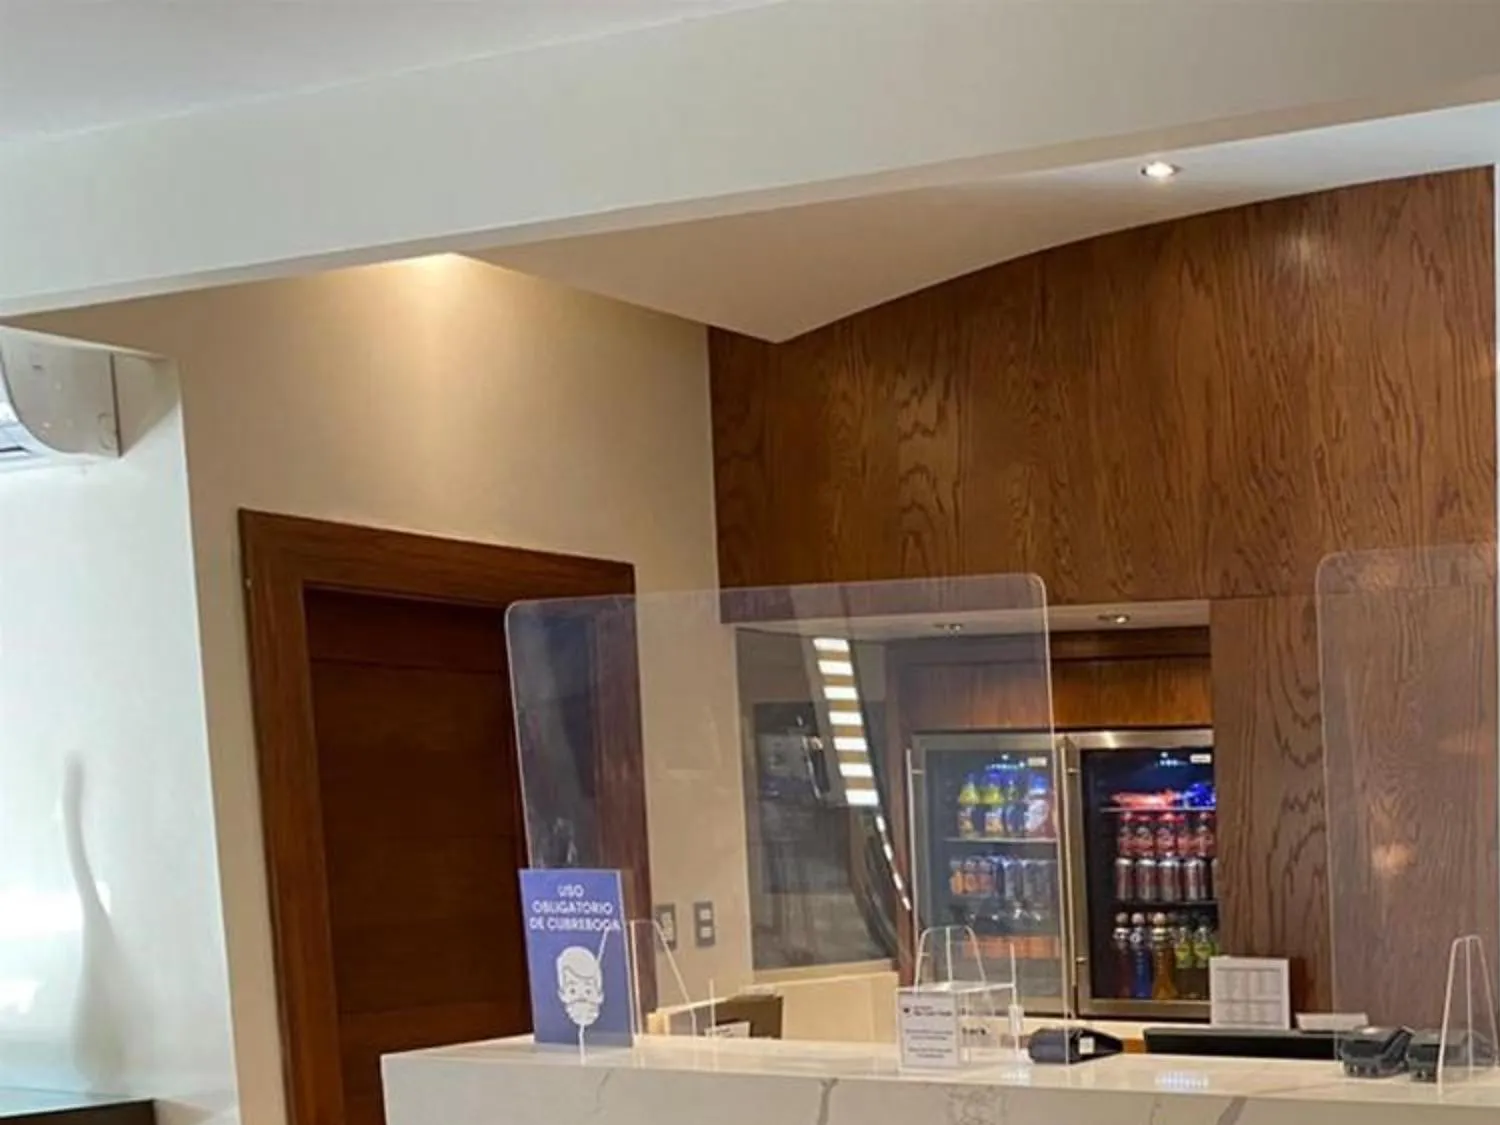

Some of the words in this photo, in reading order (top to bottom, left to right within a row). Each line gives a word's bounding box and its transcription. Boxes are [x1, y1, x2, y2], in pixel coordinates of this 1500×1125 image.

[557, 884, 585, 898] USO
[531, 900, 613, 915] OBLIGATORIO
[529, 917, 545, 930] DE
